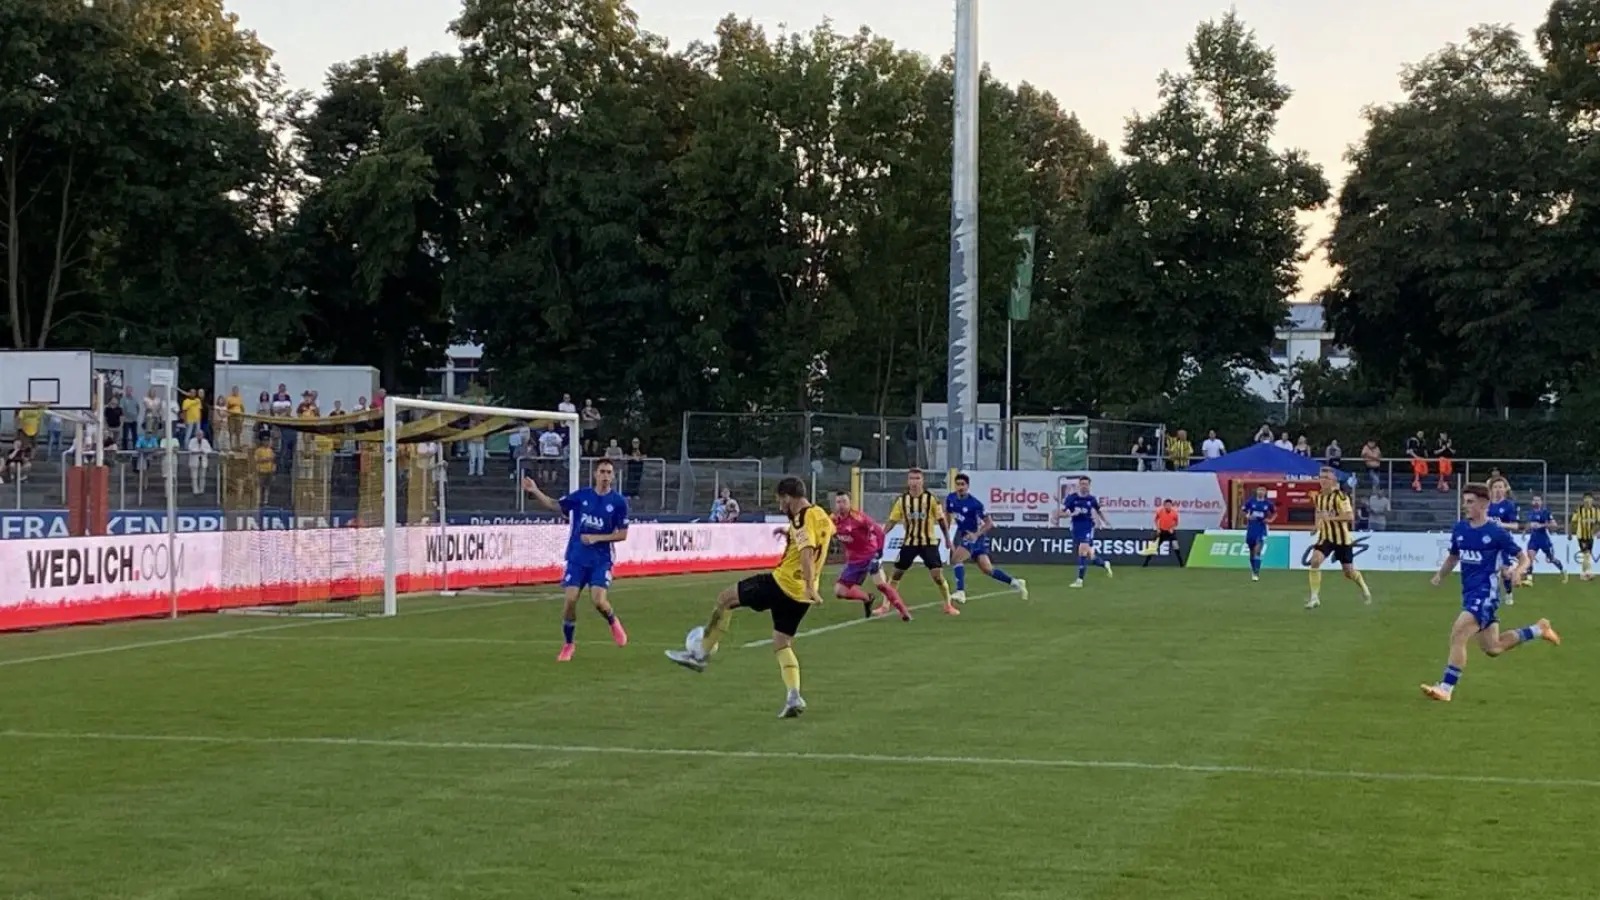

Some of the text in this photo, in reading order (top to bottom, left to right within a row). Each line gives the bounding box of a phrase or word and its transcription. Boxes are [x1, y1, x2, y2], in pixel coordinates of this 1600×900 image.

[222, 340, 233, 357] L
[990, 488, 1049, 510] Bridge
[1154, 497, 1222, 509] Bwerben.
[1041, 538, 1073, 553] THE
